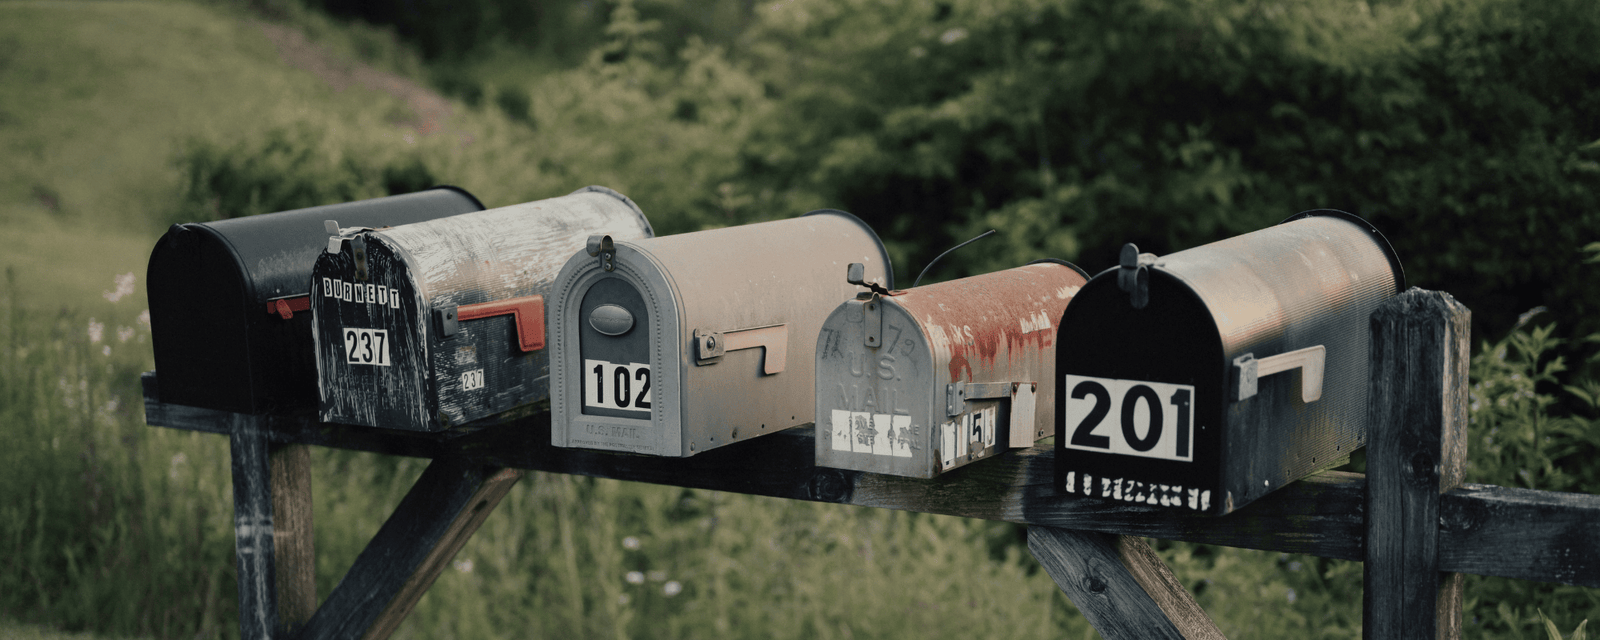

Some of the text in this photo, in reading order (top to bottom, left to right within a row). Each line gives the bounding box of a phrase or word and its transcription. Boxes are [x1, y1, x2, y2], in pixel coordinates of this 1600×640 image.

[323, 278, 399, 308] BURNETT
[346, 330, 386, 364] 237
[463, 370, 483, 389] 237
[850, 350, 901, 381] U.S.
[593, 364, 651, 409] 102
[836, 382, 909, 416] MAIL
[586, 424, 609, 436] U.S.
[1071, 380, 1191, 458] 201
